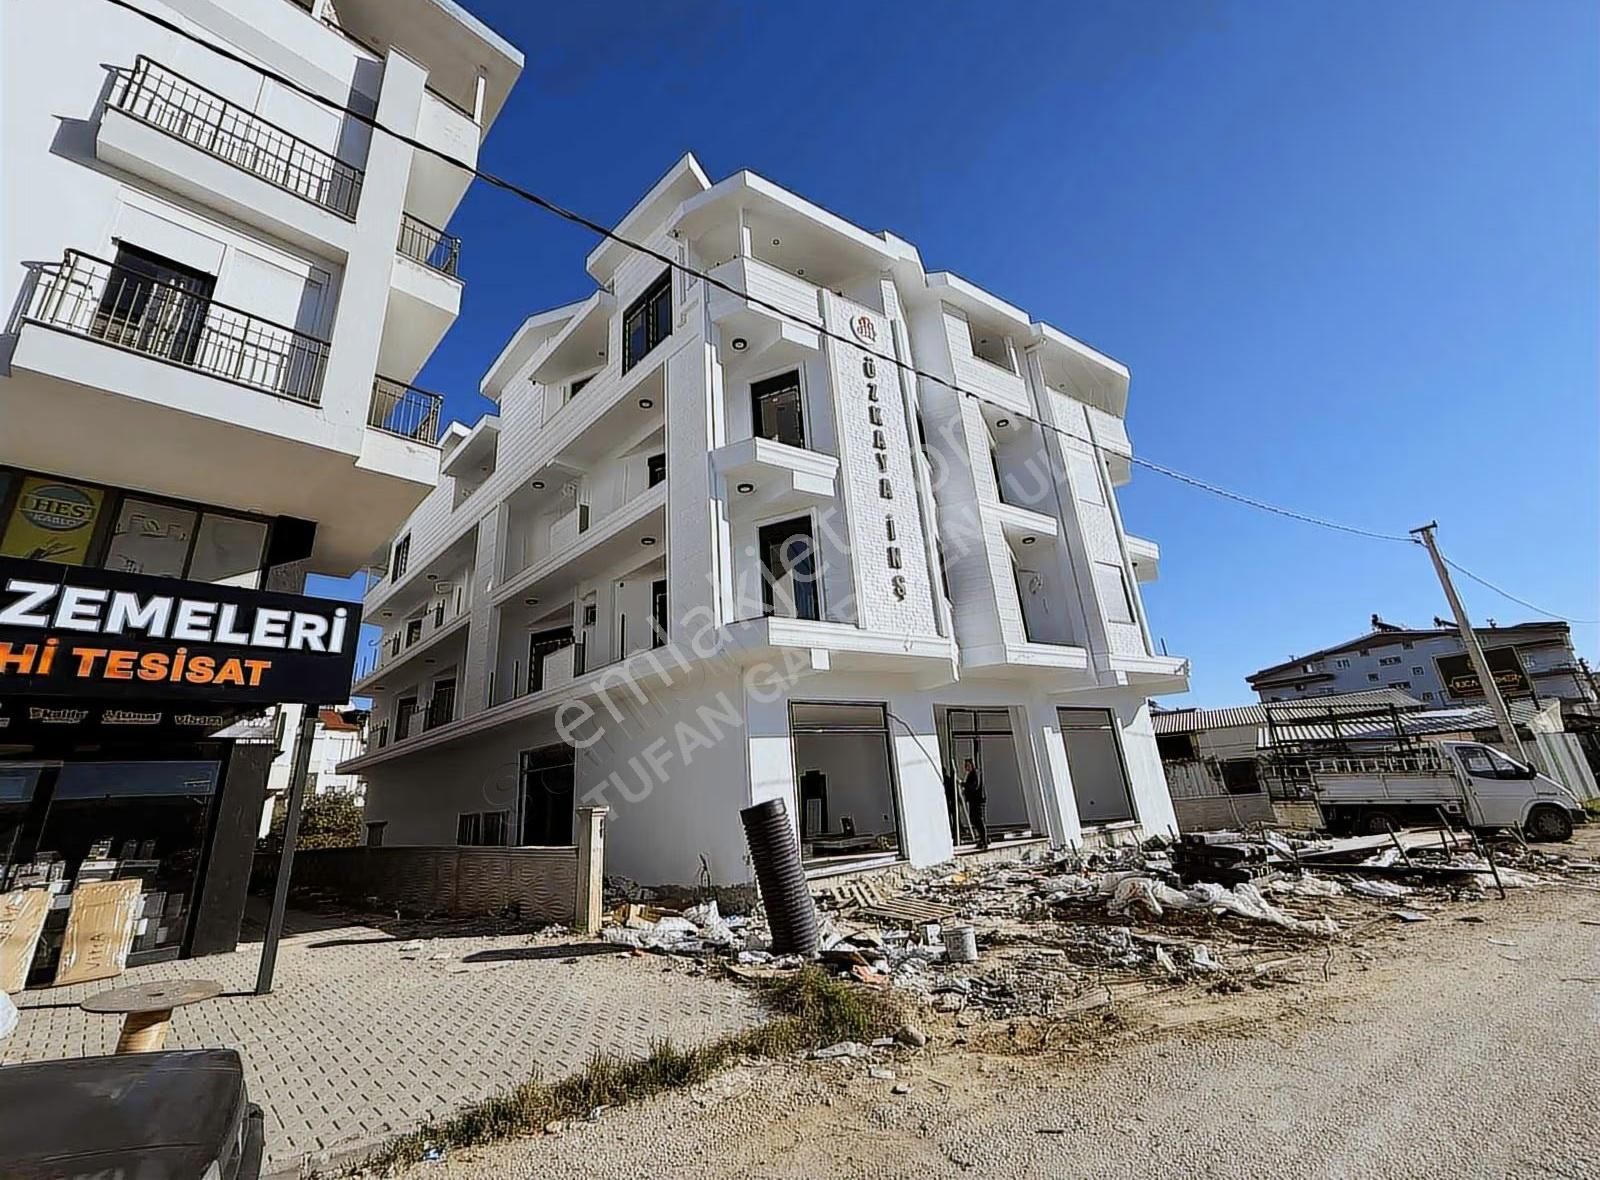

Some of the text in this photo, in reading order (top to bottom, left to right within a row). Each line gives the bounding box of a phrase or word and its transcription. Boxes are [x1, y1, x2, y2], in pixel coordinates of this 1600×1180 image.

[34, 499, 86, 518] HES
[0, 578, 348, 653] ZEMELERİ
[72, 646, 272, 687] TESİSAT
